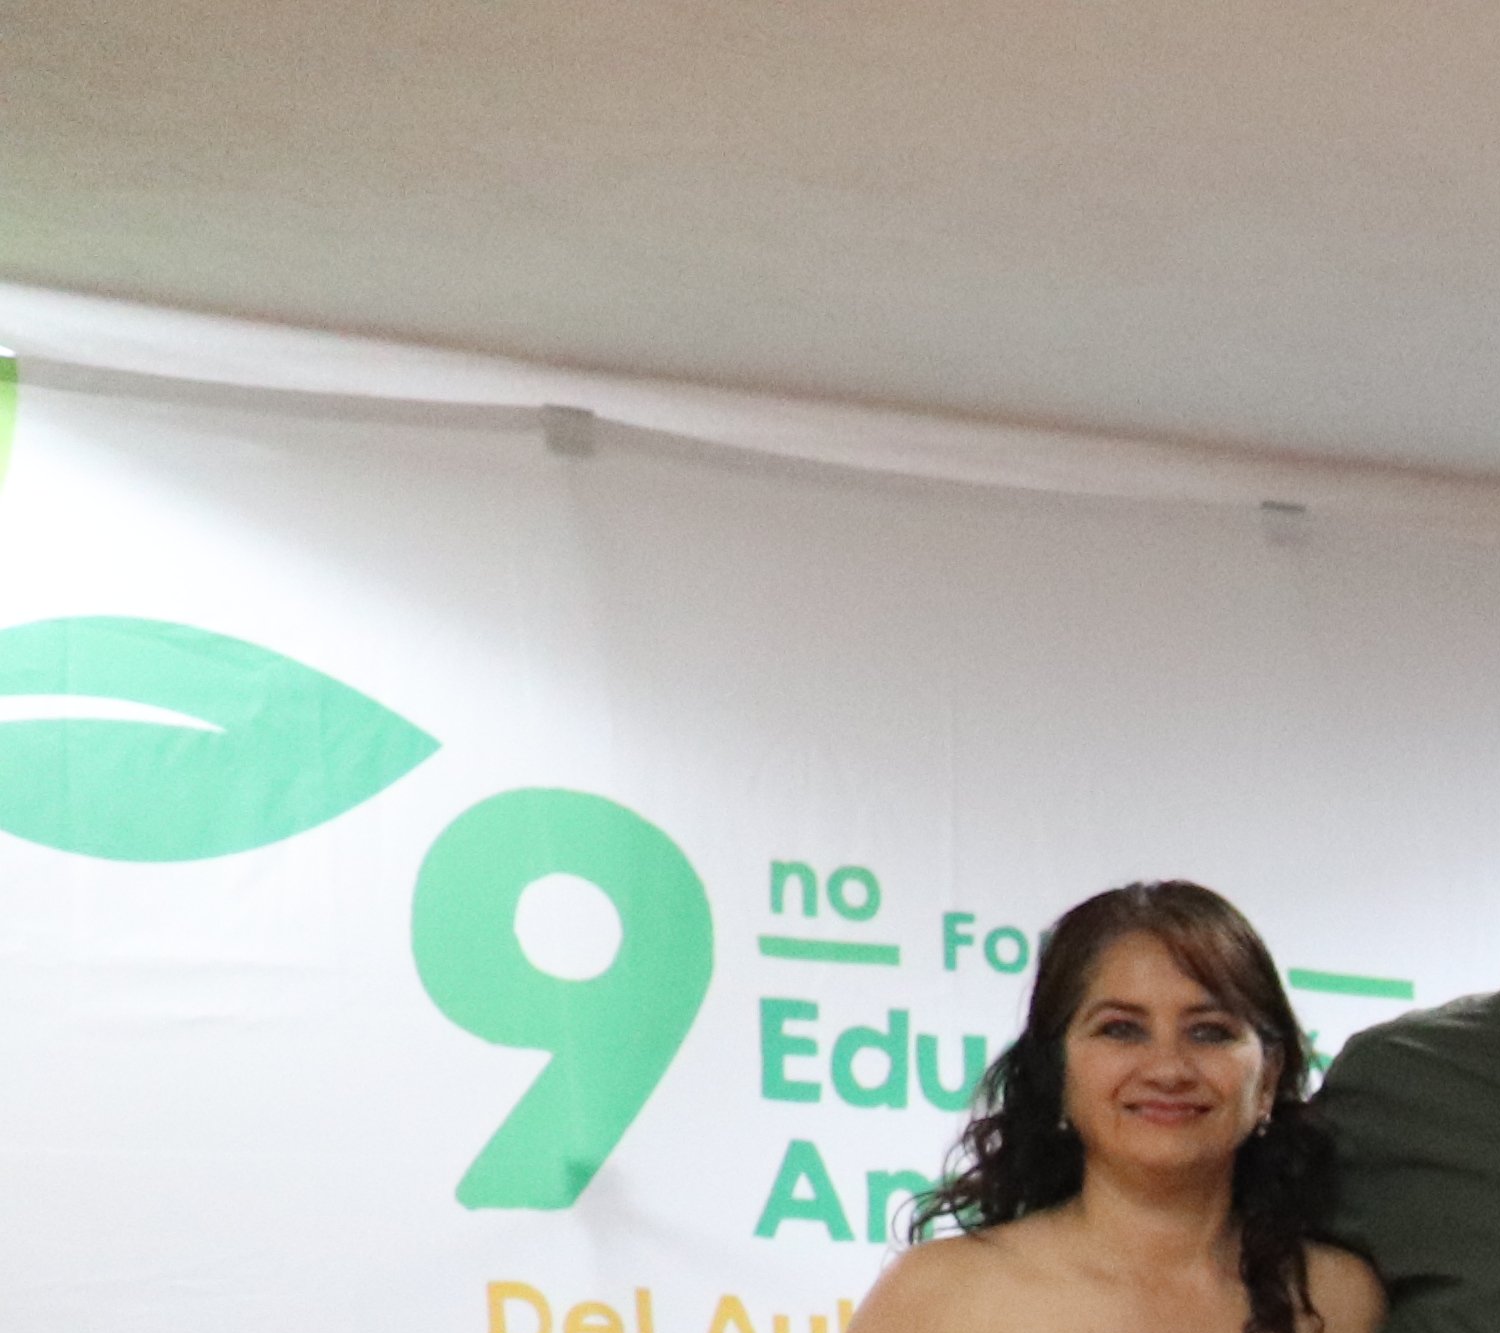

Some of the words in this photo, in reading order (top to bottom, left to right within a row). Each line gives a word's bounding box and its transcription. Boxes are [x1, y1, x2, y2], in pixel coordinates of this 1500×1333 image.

[769, 860, 882, 921] no
[942, 912, 1053, 974] Fo
[411, 787, 713, 1209] 9
[758, 998, 1012, 1113] Edu
